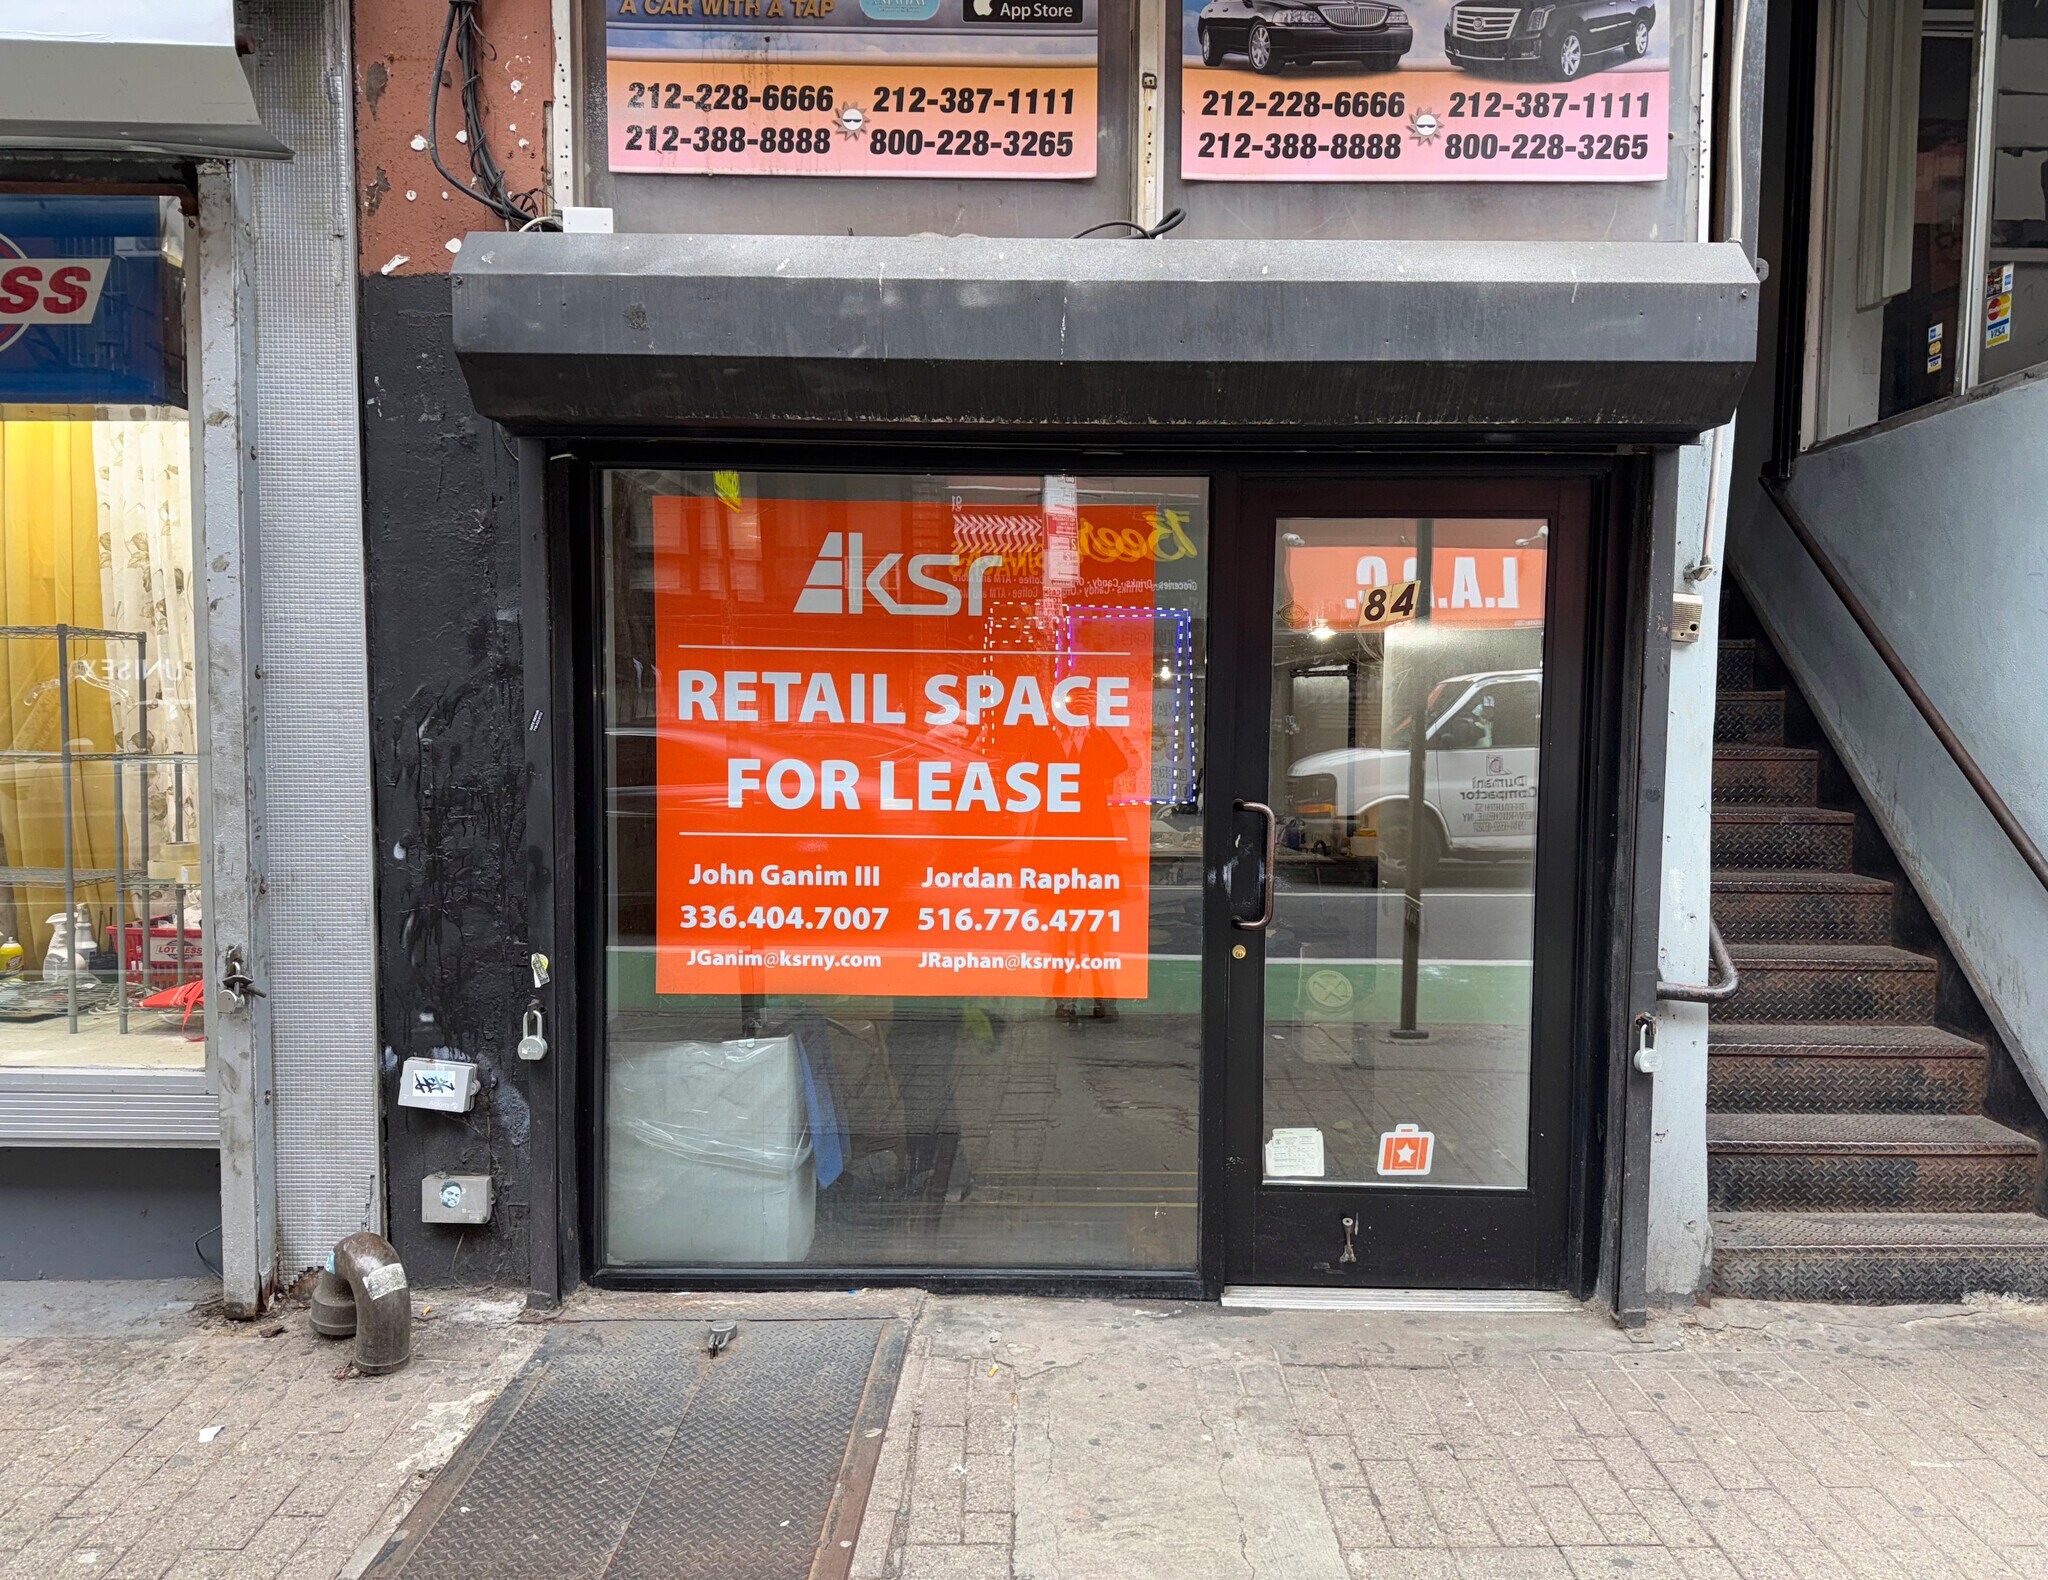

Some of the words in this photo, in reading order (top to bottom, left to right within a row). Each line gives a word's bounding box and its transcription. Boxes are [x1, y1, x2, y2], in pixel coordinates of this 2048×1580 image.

[619, 0, 637, 14] A
[645, 0, 693, 16] CAR
[702, 0, 760, 17] WITH
[767, 0, 784, 17] A
[791, 1, 836, 18] TAP
[1000, 3, 1031, 20] App
[1034, 3, 1073, 18] Store
[628, 83, 833, 111] 212-228-6666
[873, 87, 1074, 114] 212-387-1111
[1201, 90, 1405, 118] 212-228-6666
[1449, 92, 1650, 118] 212-387-1111
[625, 126, 831, 153] 212-388-8888
[870, 130, 1073, 157] 800-228-3265
[1198, 133, 1401, 159] 212-388-8888
[1445, 134, 1648, 160] 800-228-3265
[1991, 327, 2005, 338] VISA
[1364, 584, 1415, 622] 84
[679, 670, 906, 724] RETAIL
[924, 675, 1131, 728] SPACE
[727, 758, 861, 811] FOR
[880, 760, 1081, 813] LEASE
[688, 864, 754, 886] John
[761, 865, 849, 886] Ganim
[855, 866, 880, 887] III
[921, 867, 1014, 889] Jordan
[1020, 868, 1120, 895] Raphan
[680, 905, 889, 931] 336.404.7007
[917, 908, 1121, 933] 516.776.4771
[686, 949, 882, 972] JGanim@ksrny.com
[918, 952, 1122, 975] JRaphan@ksrny.com
